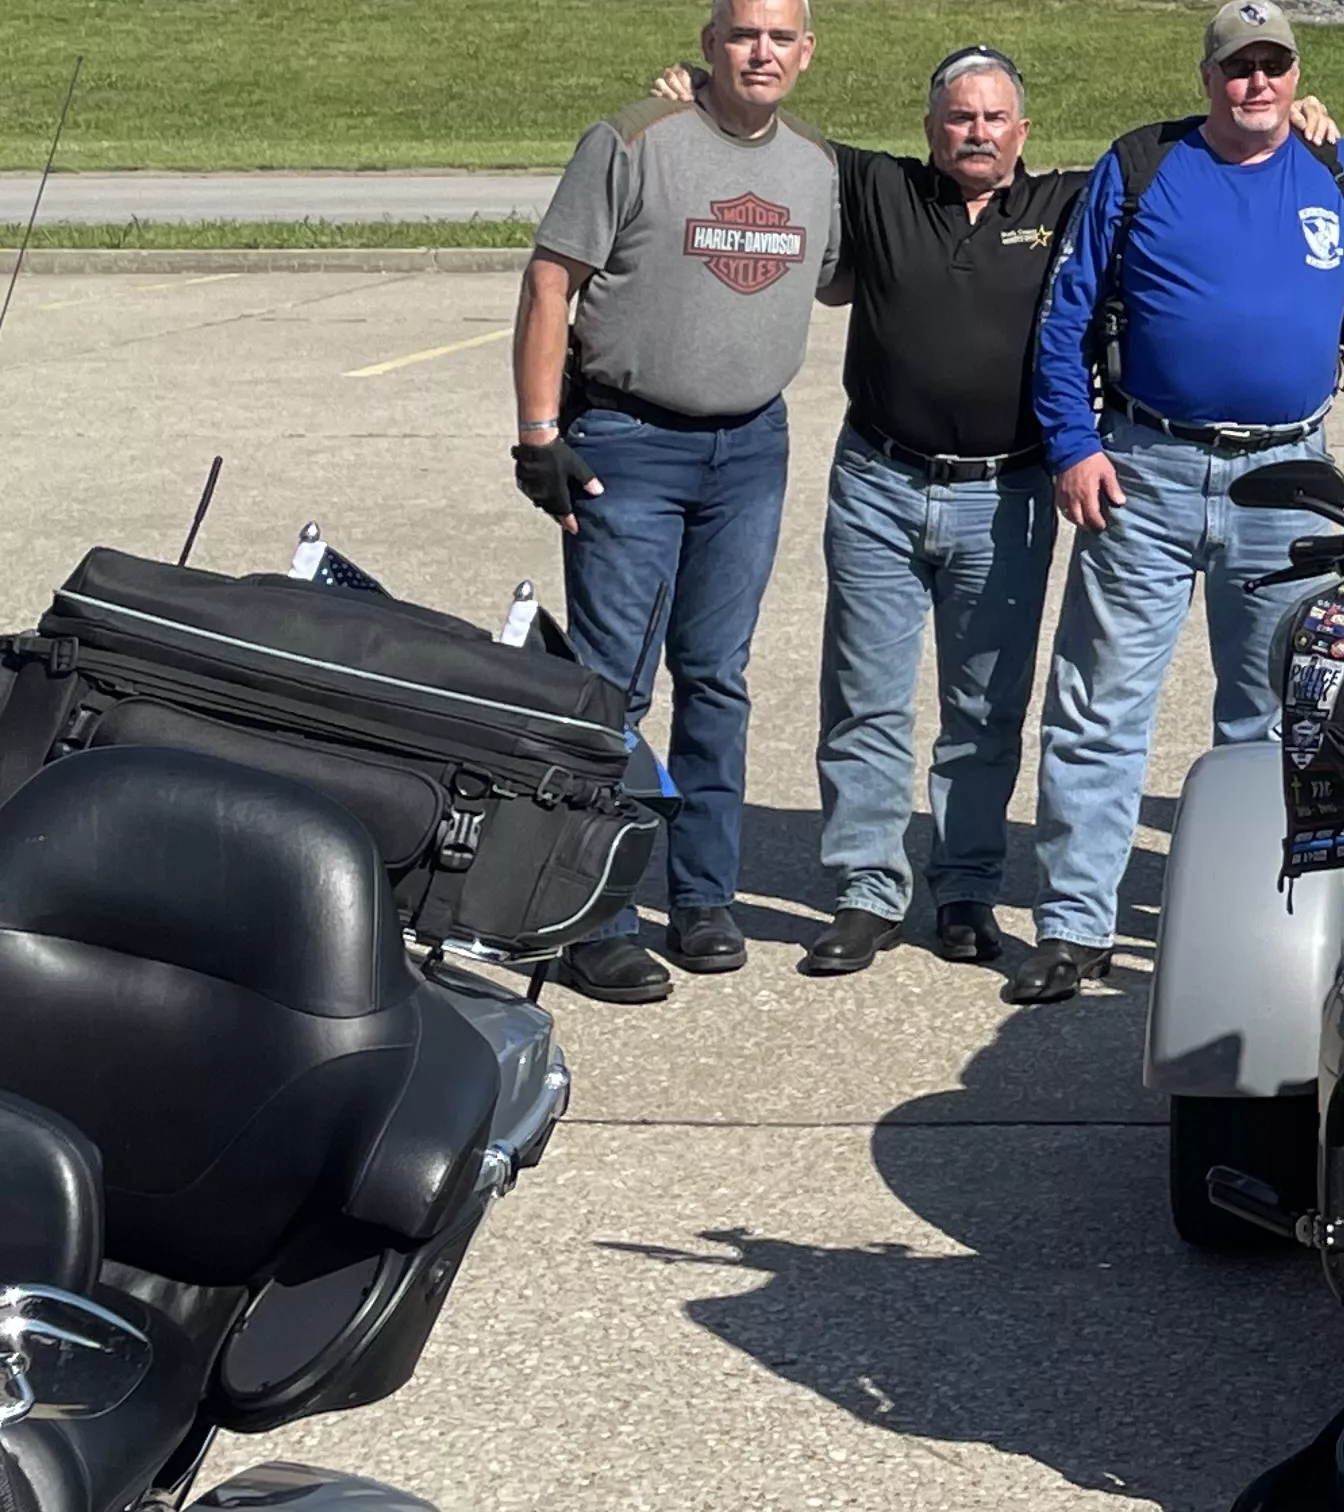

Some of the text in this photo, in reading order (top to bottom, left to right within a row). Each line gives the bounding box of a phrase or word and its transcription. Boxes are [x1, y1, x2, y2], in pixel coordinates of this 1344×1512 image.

[723, 201, 779, 226] MOTOR
[693, 226, 801, 255] HARLEY-DAVIDSON
[719, 257, 778, 287] CYCLES
